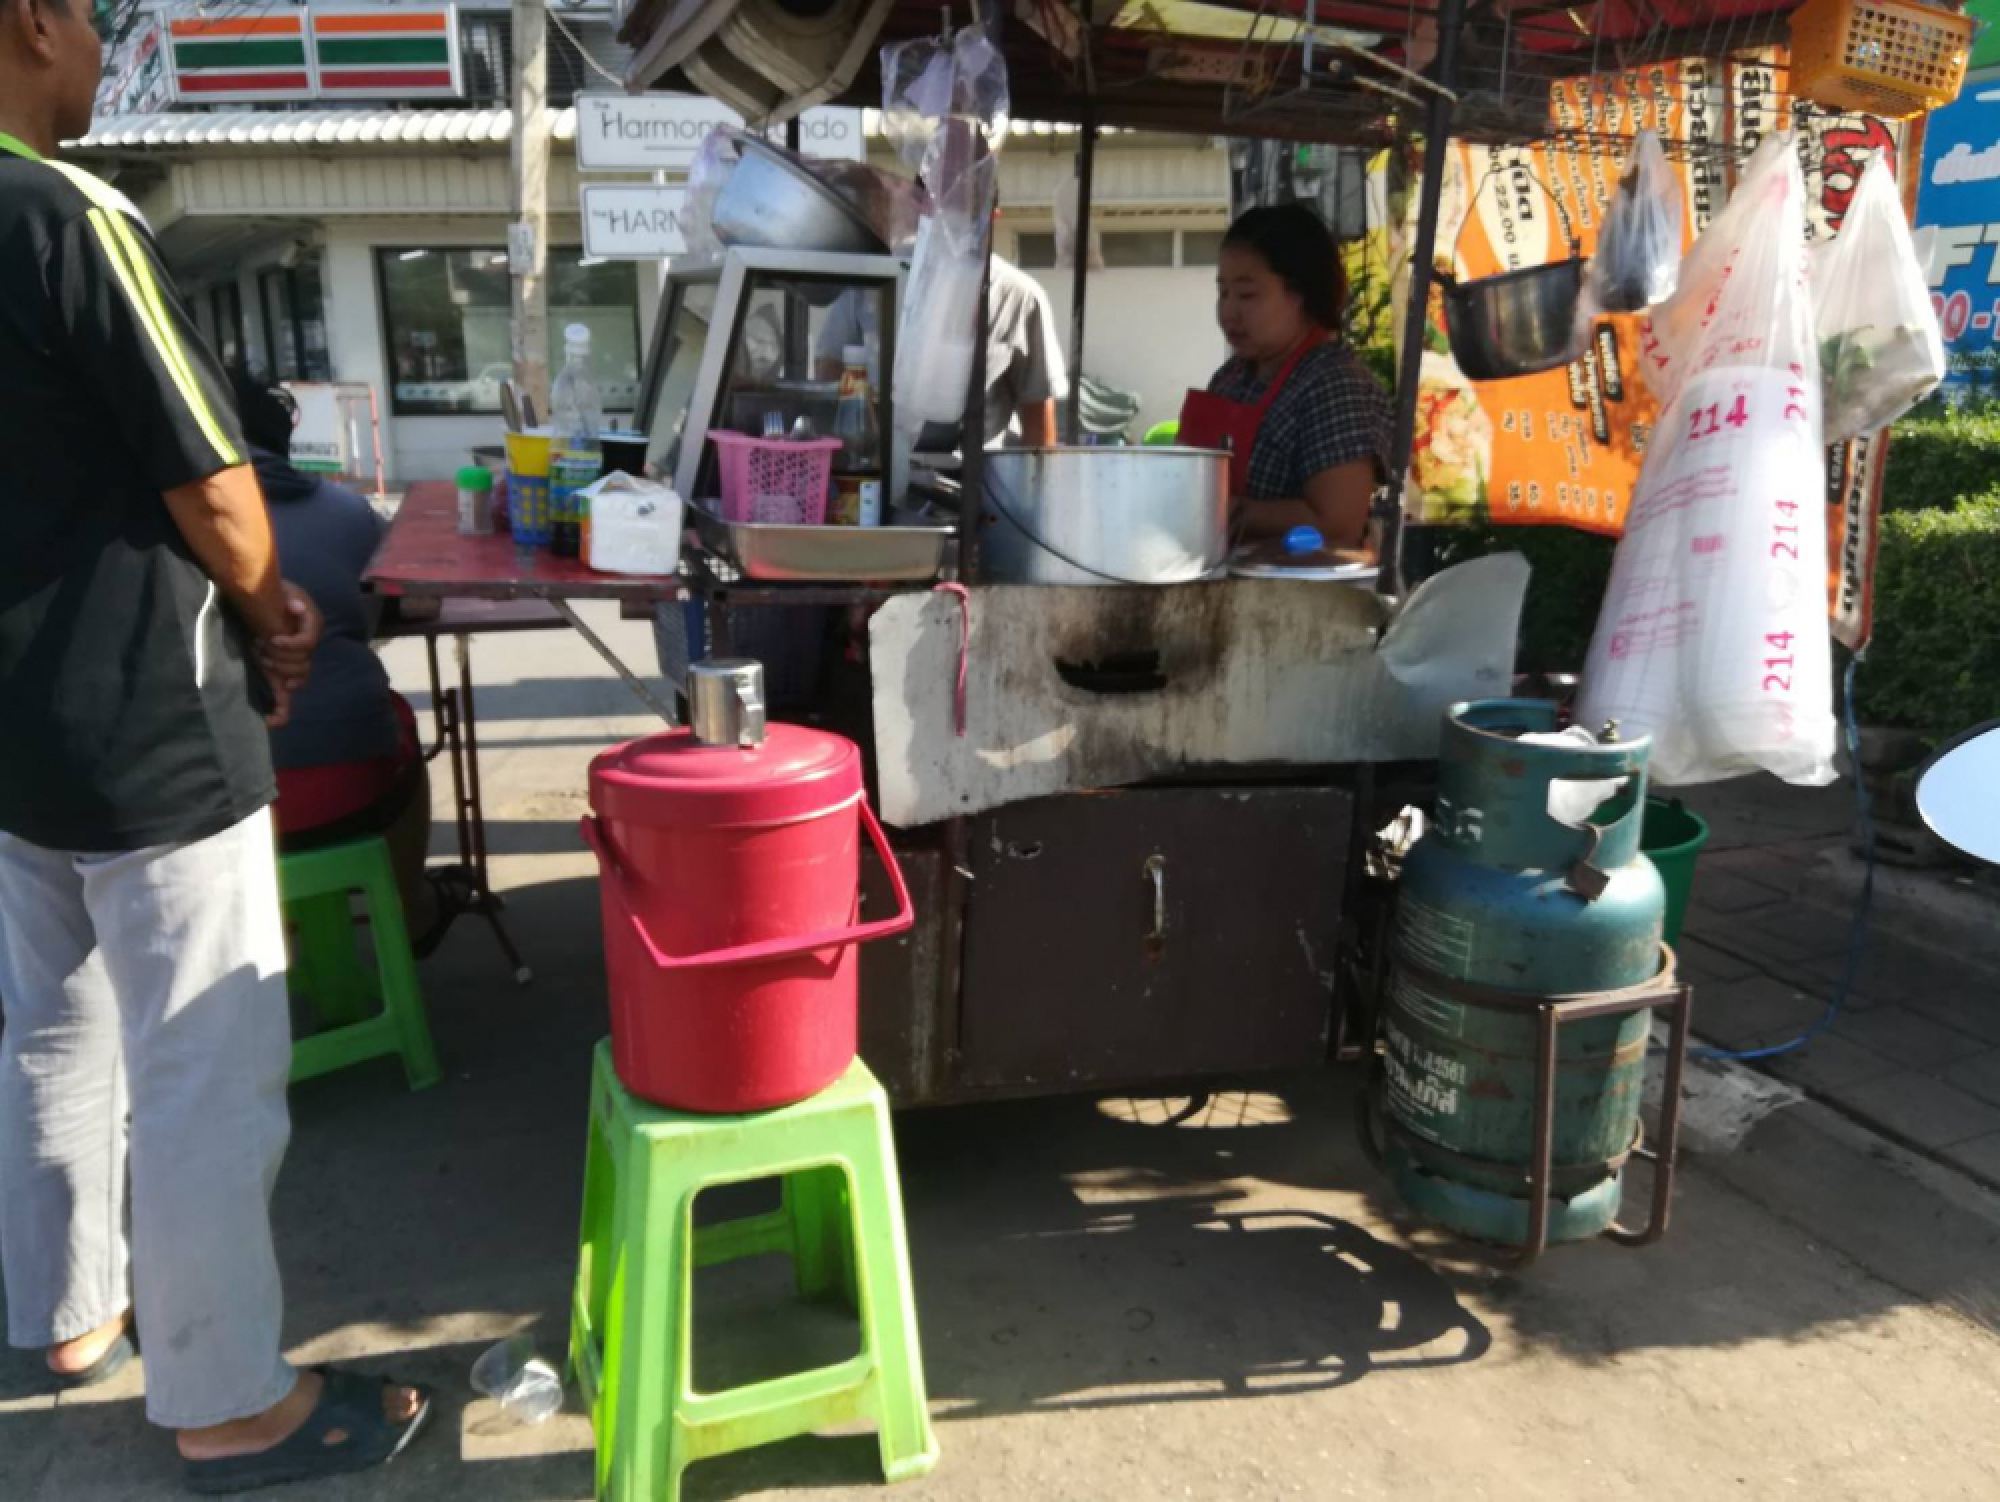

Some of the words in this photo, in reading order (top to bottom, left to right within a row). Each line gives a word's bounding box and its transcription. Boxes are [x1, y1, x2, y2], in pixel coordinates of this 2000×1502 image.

[601, 111, 710, 140] Harmon
[1688, 394, 1749, 440] 214
[1770, 499, 1799, 560] 214
[1763, 630, 1794, 692] 214
